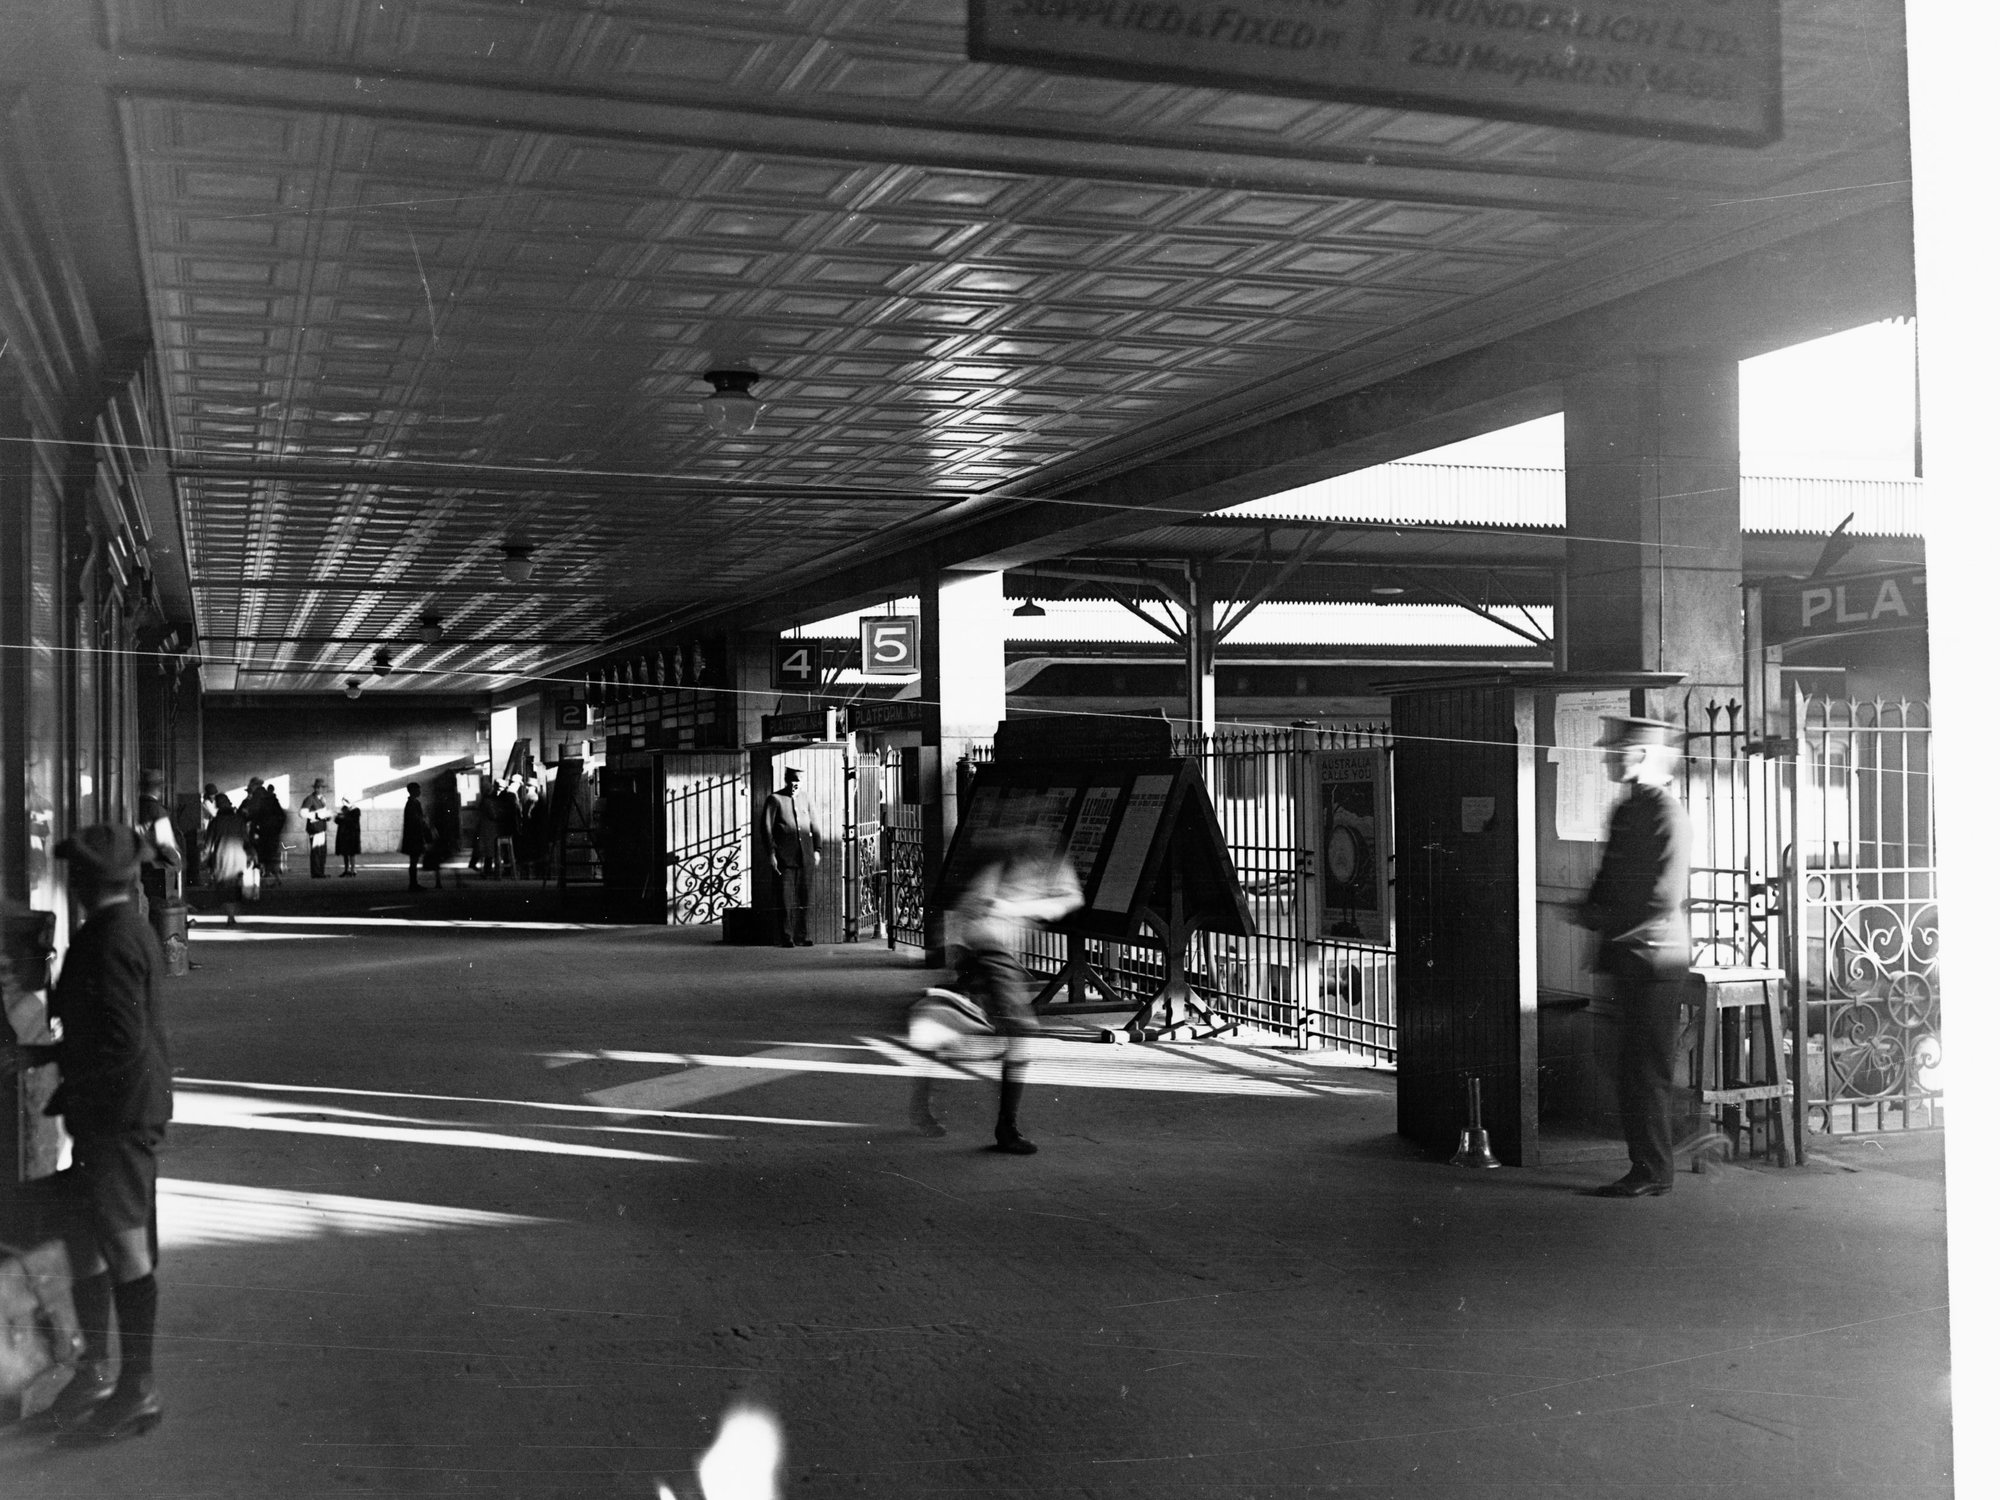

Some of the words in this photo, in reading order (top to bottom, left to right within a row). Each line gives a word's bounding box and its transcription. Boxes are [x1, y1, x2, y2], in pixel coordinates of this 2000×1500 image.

[1802, 576, 1926, 627] PLA
[873, 627, 908, 662] 5
[782, 649, 811, 679] 4
[563, 706, 581, 724] 2
[769, 715, 807, 732] PLATFORM
[855, 704, 903, 725] PLATFORM
[1321, 757, 1371, 770] AUSTRALIA
[1321, 769, 1349, 781] CALLS
[1352, 768, 1371, 780] YOU
